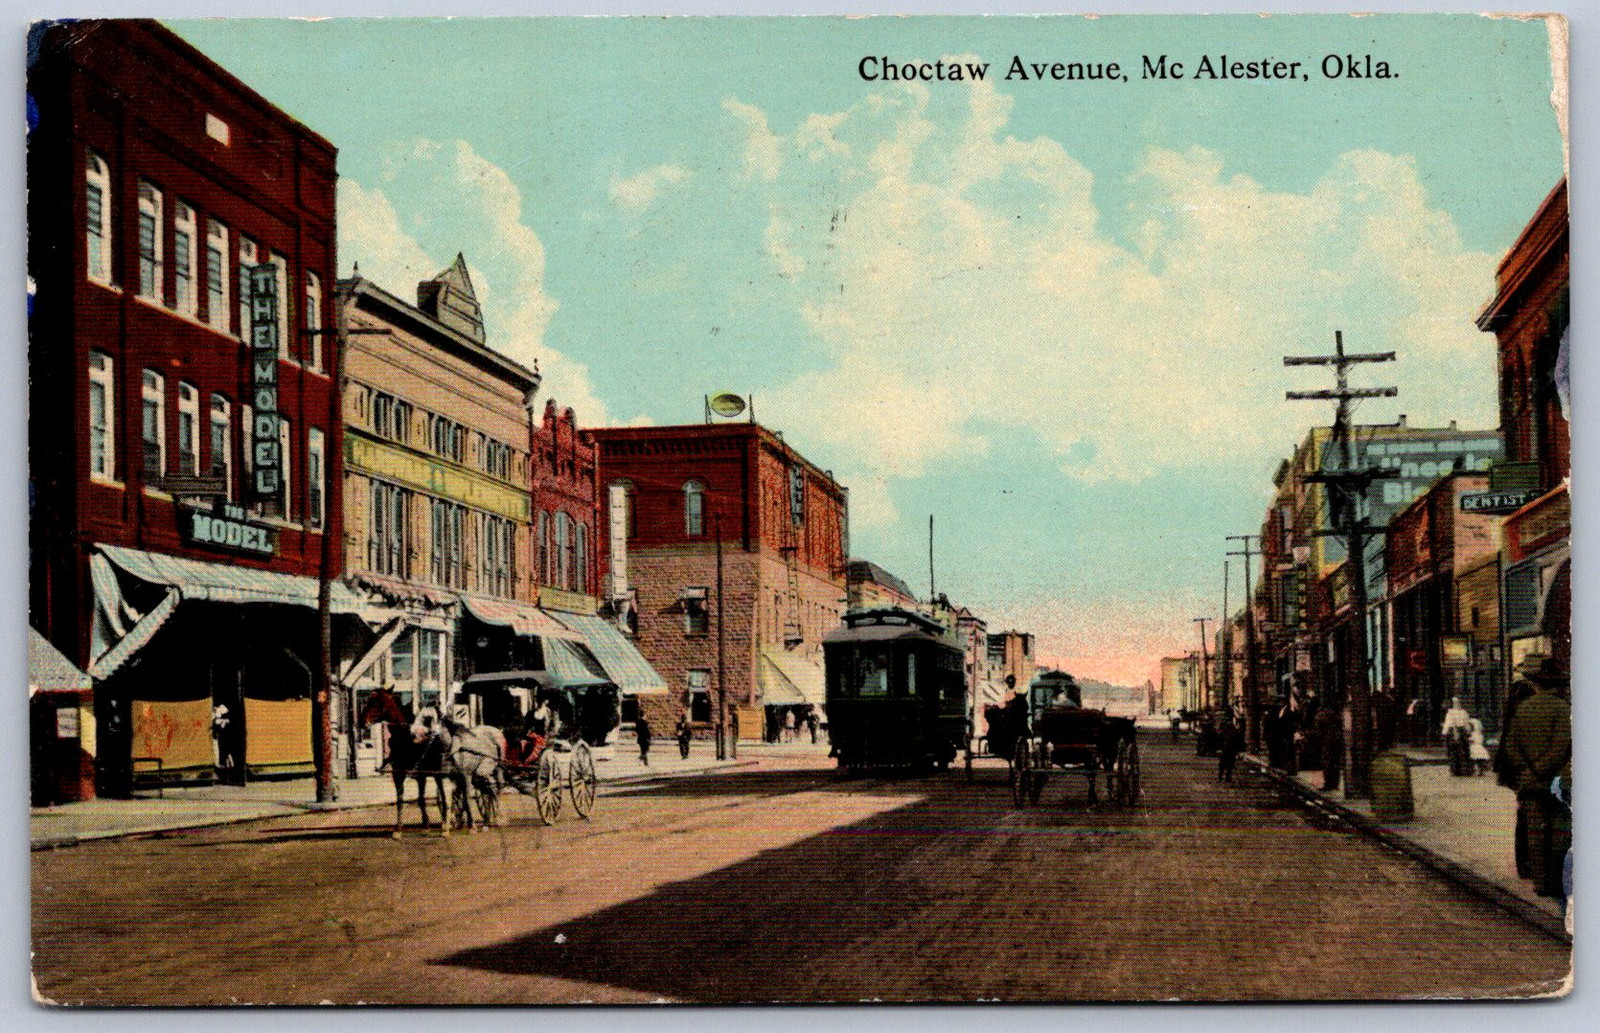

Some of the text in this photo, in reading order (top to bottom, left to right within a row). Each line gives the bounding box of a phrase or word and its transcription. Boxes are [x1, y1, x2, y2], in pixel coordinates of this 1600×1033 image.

[252, 272, 277, 493] THE MODEL
[1463, 494, 1527, 509] DENTIST
[192, 514, 273, 553] MODEL
